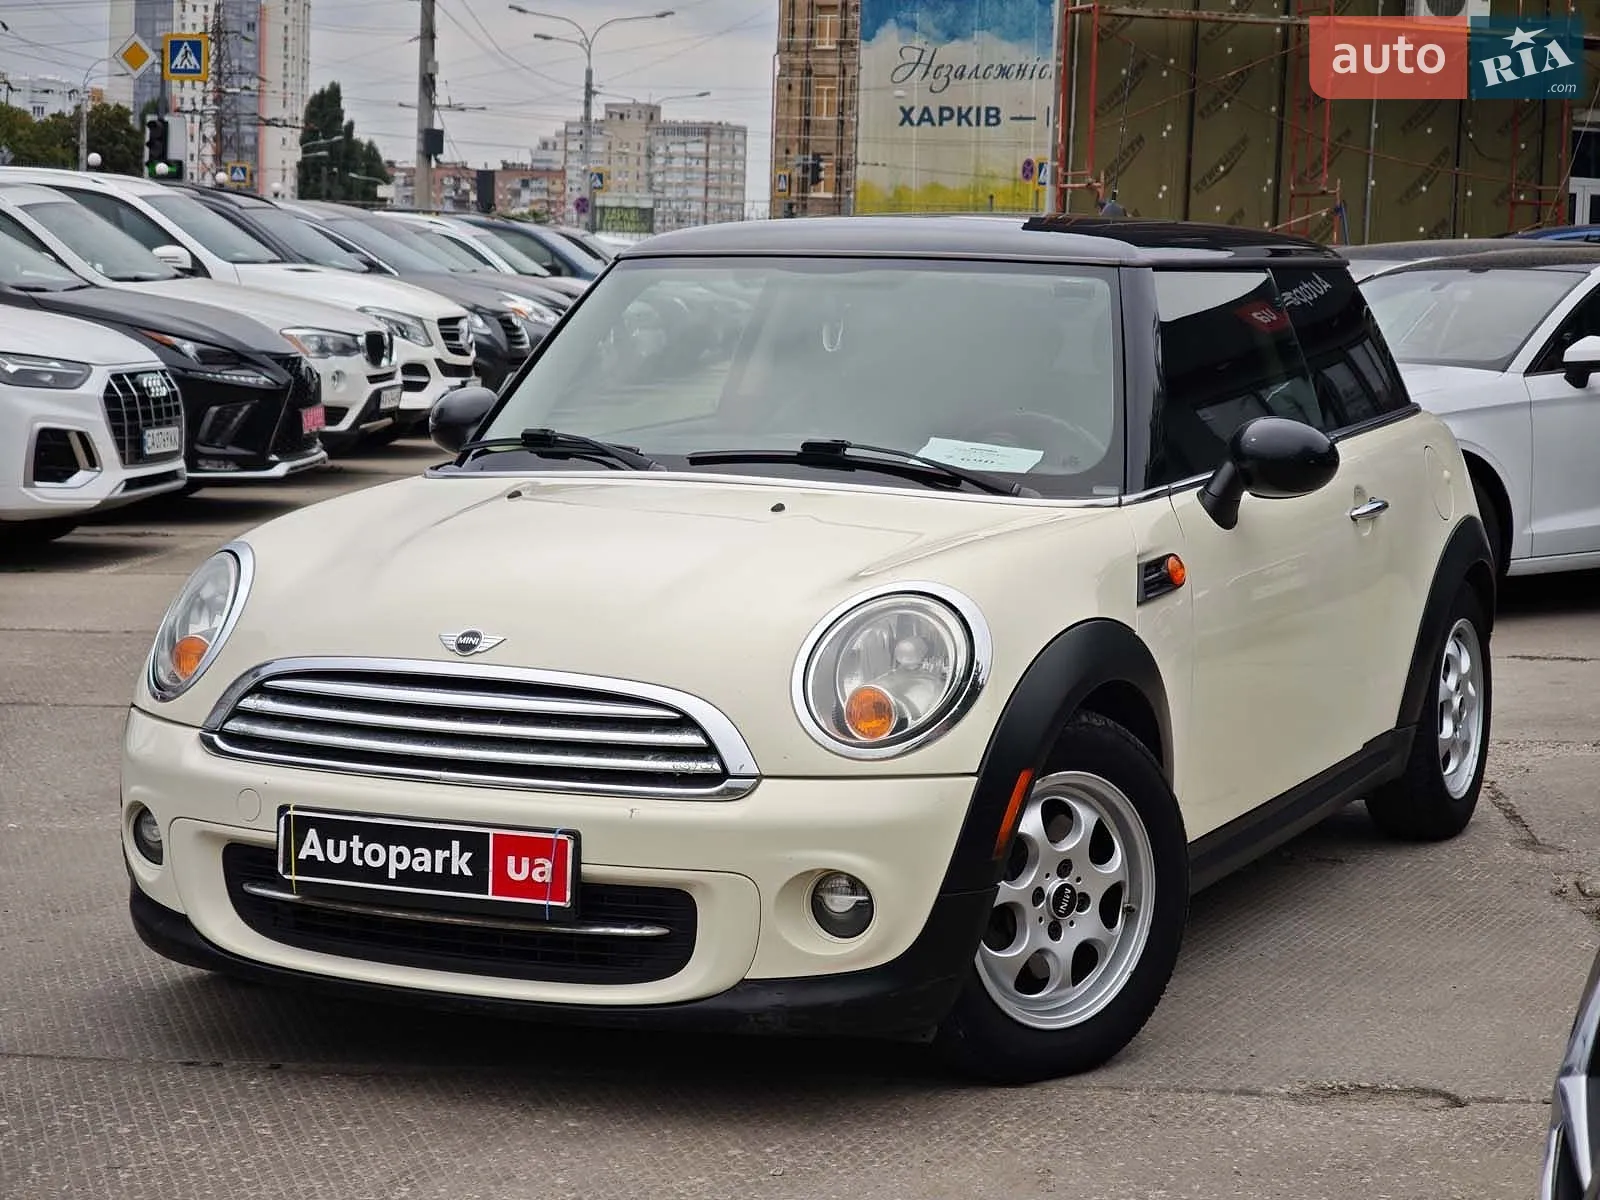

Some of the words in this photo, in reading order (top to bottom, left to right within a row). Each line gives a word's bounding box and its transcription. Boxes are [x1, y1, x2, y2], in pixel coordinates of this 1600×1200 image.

[891, 45, 1052, 93] Незалежніс
[898, 105, 1002, 127] ХАРКІВ
[457, 636, 480, 645] MINI
[298, 828, 473, 879] Autopark
[506, 855, 552, 883] ua
[1058, 887, 1072, 914] MINI
